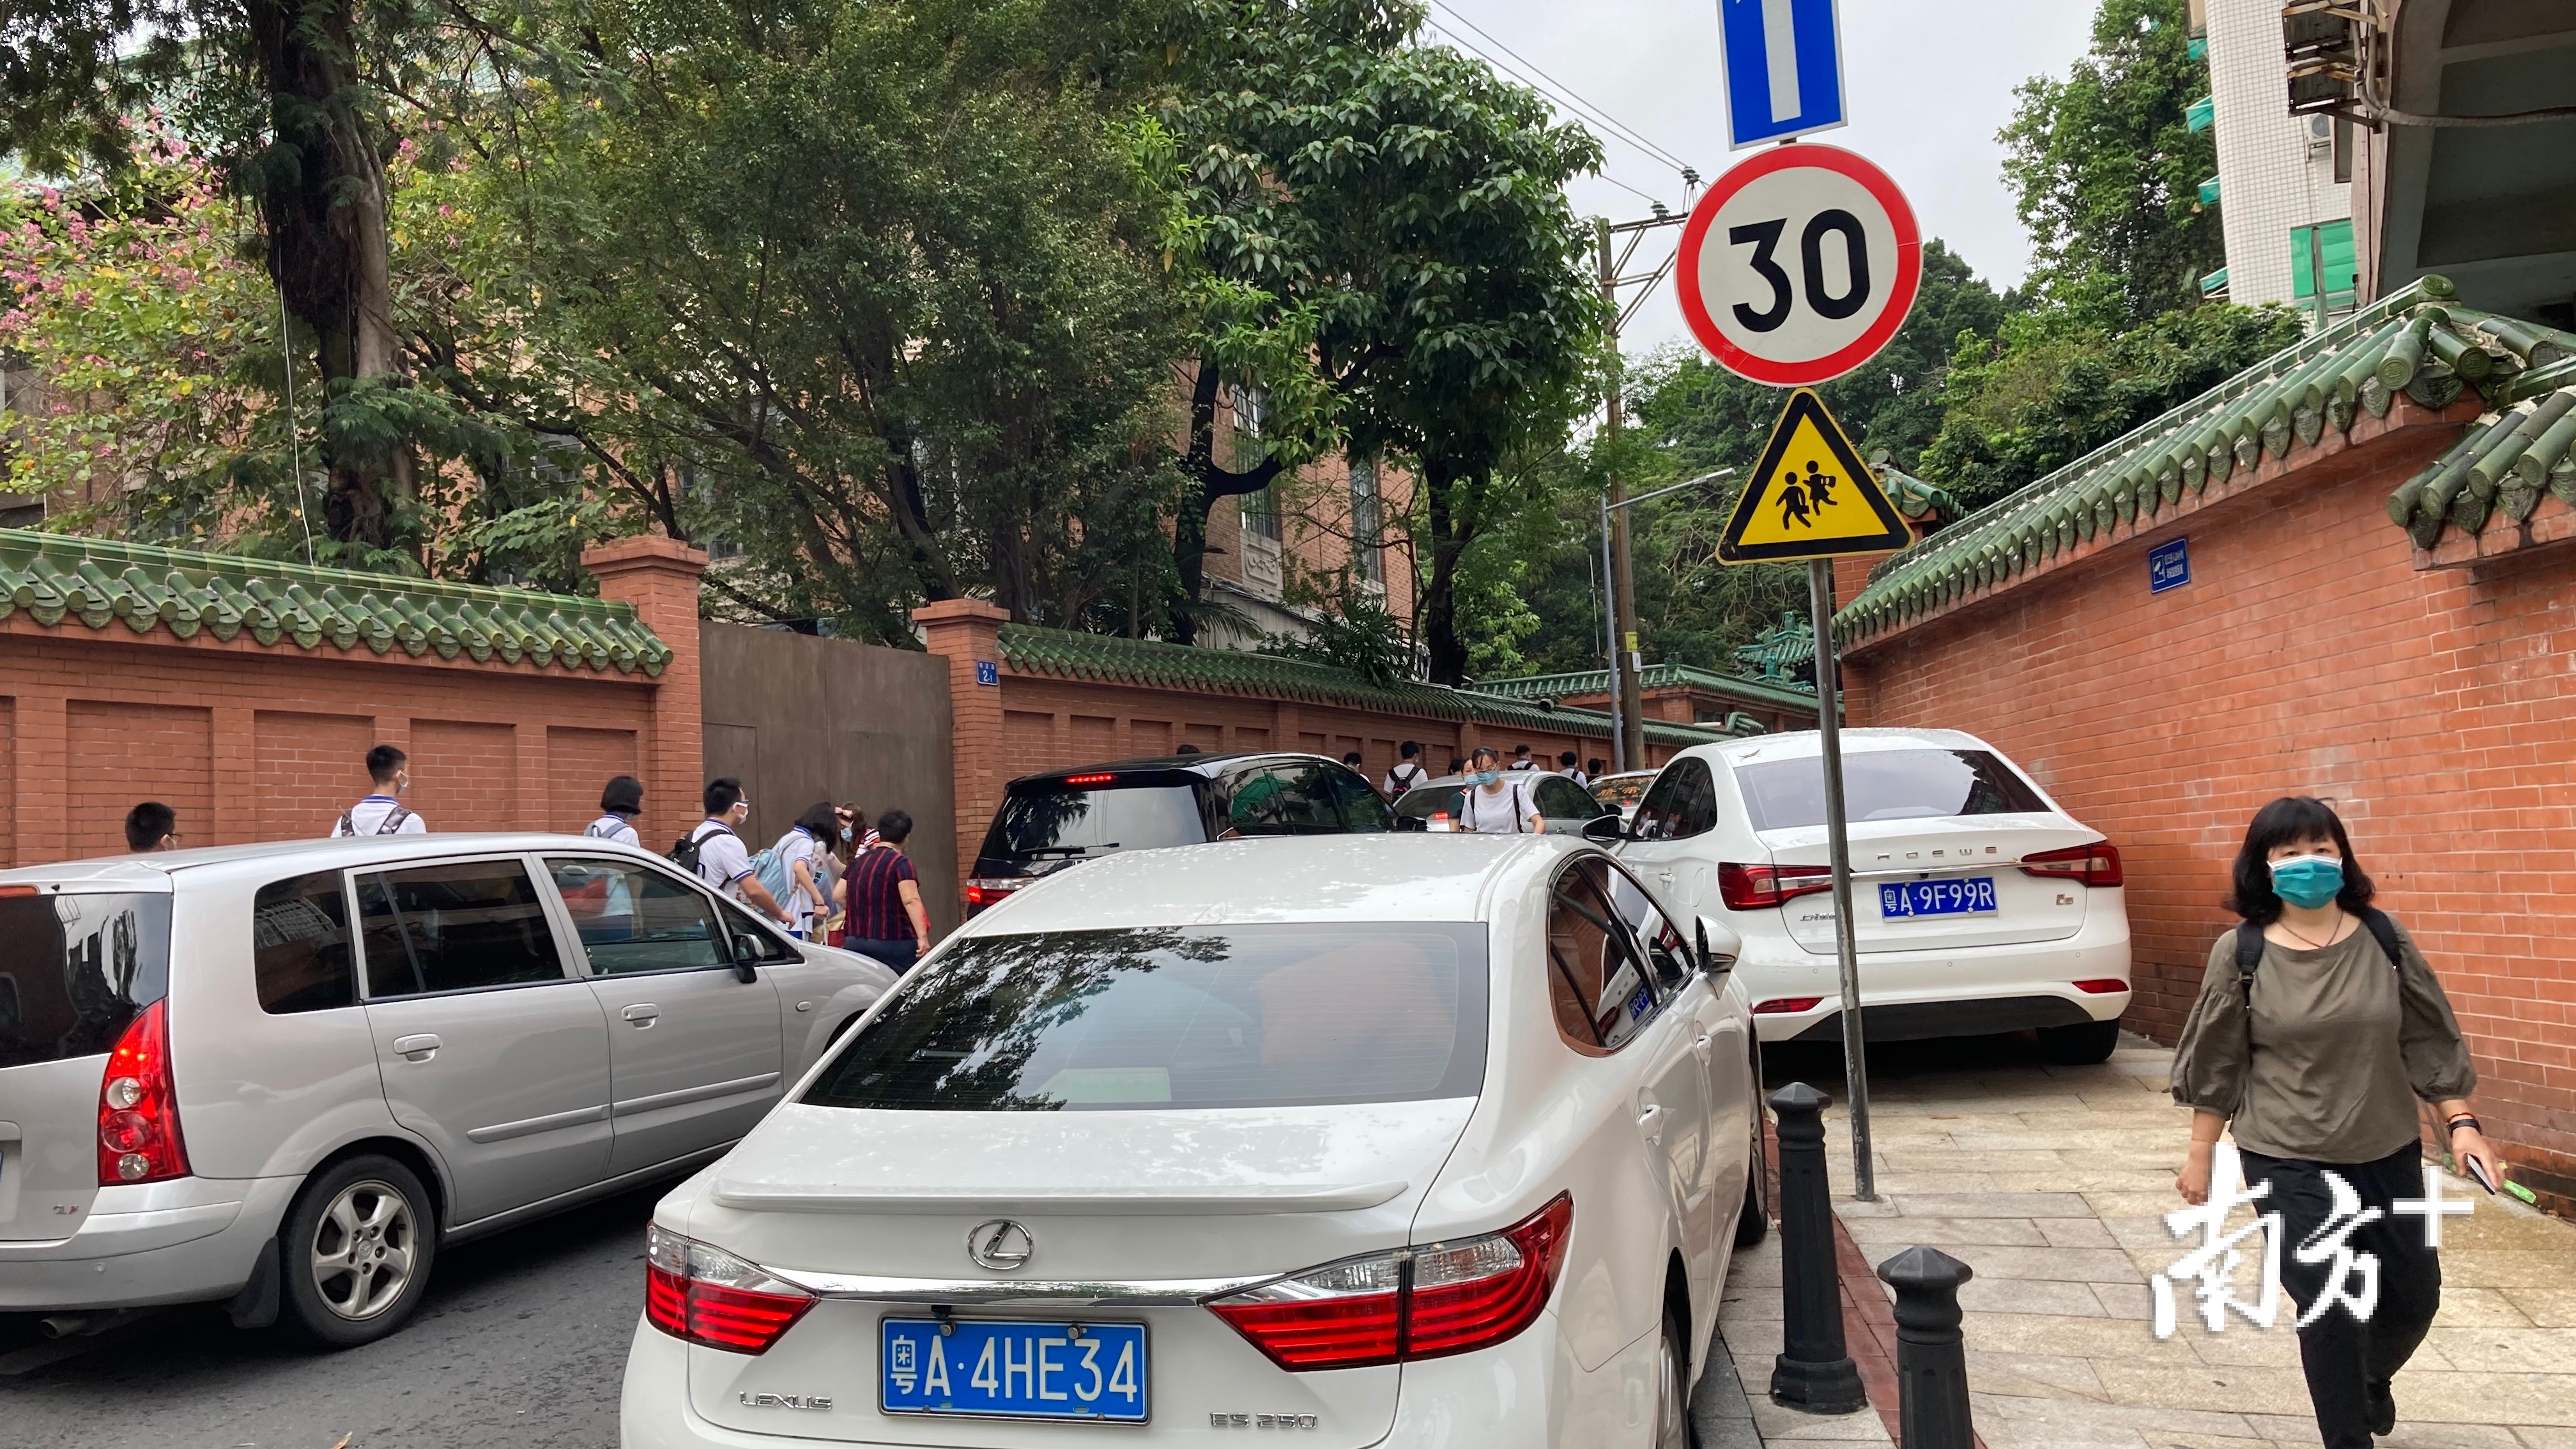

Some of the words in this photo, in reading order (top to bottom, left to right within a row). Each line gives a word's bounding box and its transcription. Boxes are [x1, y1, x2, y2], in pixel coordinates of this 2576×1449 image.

[1729, 209, 1871, 332] 30
[891, 1334, 1138, 1403] 粤A·4HE34
[739, 1391, 833, 1410] LEXUS
[1209, 1412, 1250, 1428] ES
[1256, 1413, 1318, 1429] 250
